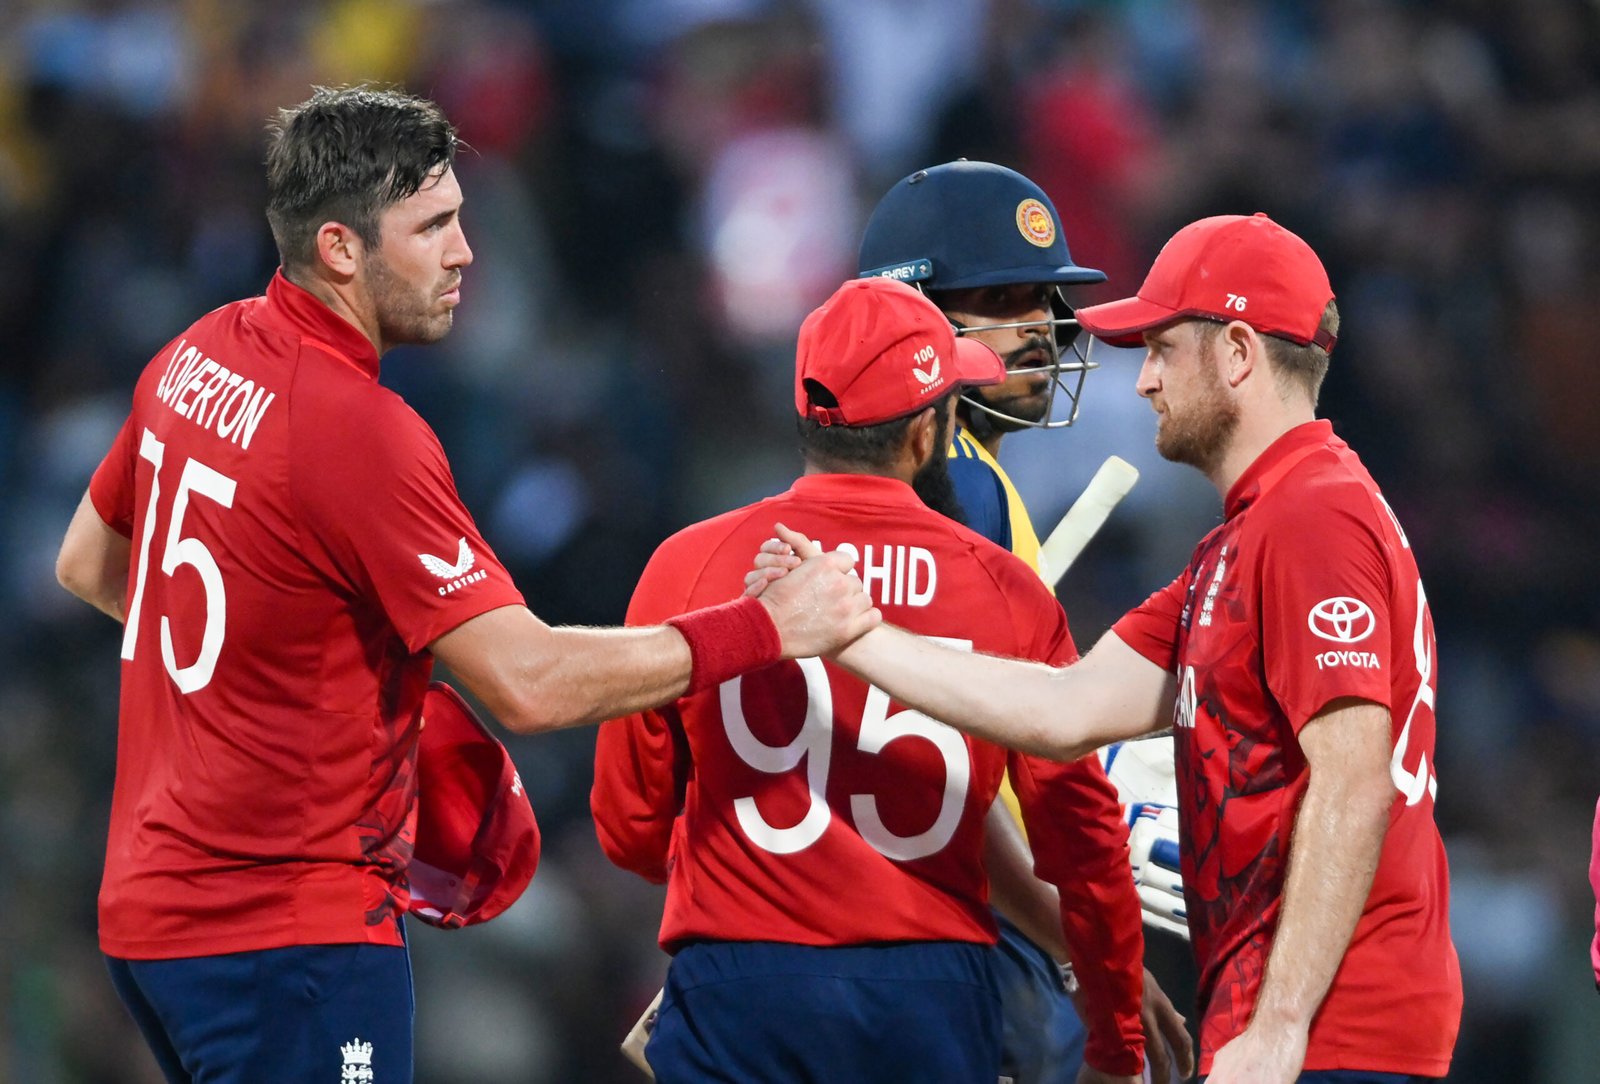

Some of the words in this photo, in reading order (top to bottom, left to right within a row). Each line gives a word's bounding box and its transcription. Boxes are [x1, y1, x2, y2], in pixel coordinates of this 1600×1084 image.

[1225, 293, 1247, 312] 76
[913, 345, 935, 365] 100
[120, 427, 237, 694] 75
[438, 569, 487, 596] CASTORE
[1314, 650, 1381, 670] TOYOTA
[719, 635, 974, 861] 95
